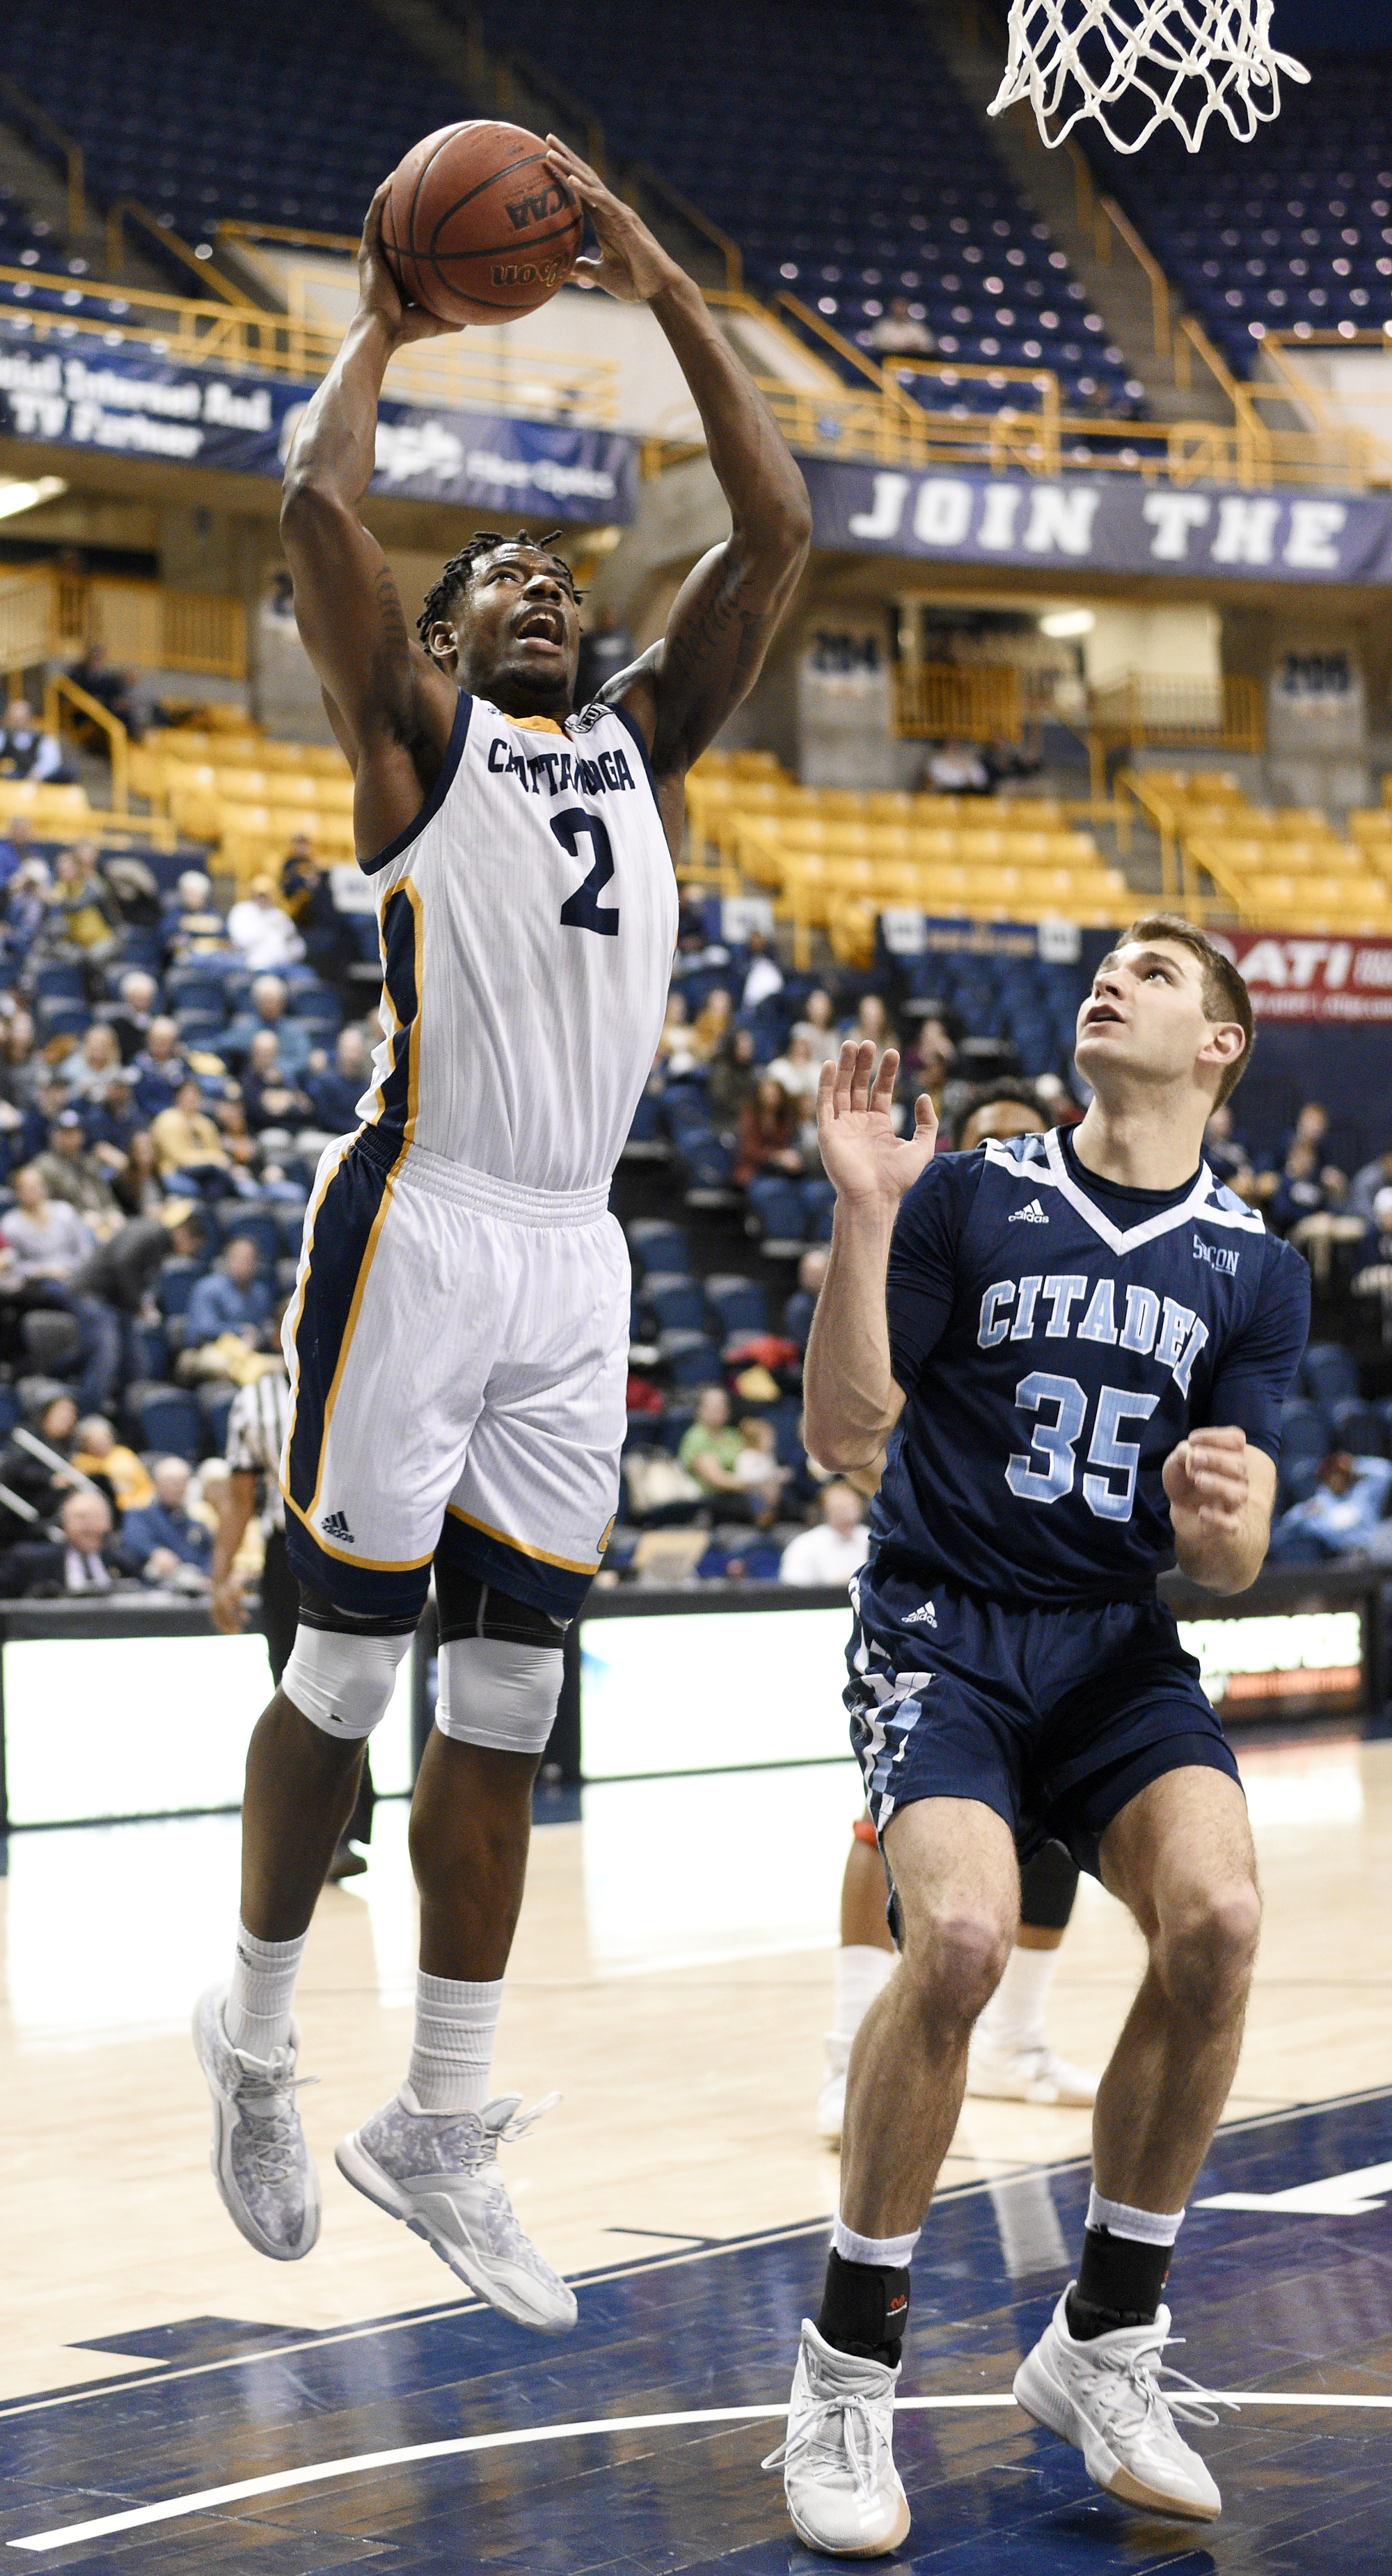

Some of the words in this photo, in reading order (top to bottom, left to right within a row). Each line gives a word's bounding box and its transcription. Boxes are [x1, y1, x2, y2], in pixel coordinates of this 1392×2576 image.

[849, 473, 1100, 556] JOIN
[1142, 492, 1348, 570] THE
[488, 738, 636, 796] CATTANOGA
[549, 807, 620, 936] 2
[1236, 940, 1354, 989] ATI
[1004, 1370, 1161, 1523] 35
[901, 1611, 938, 1628] adidas
